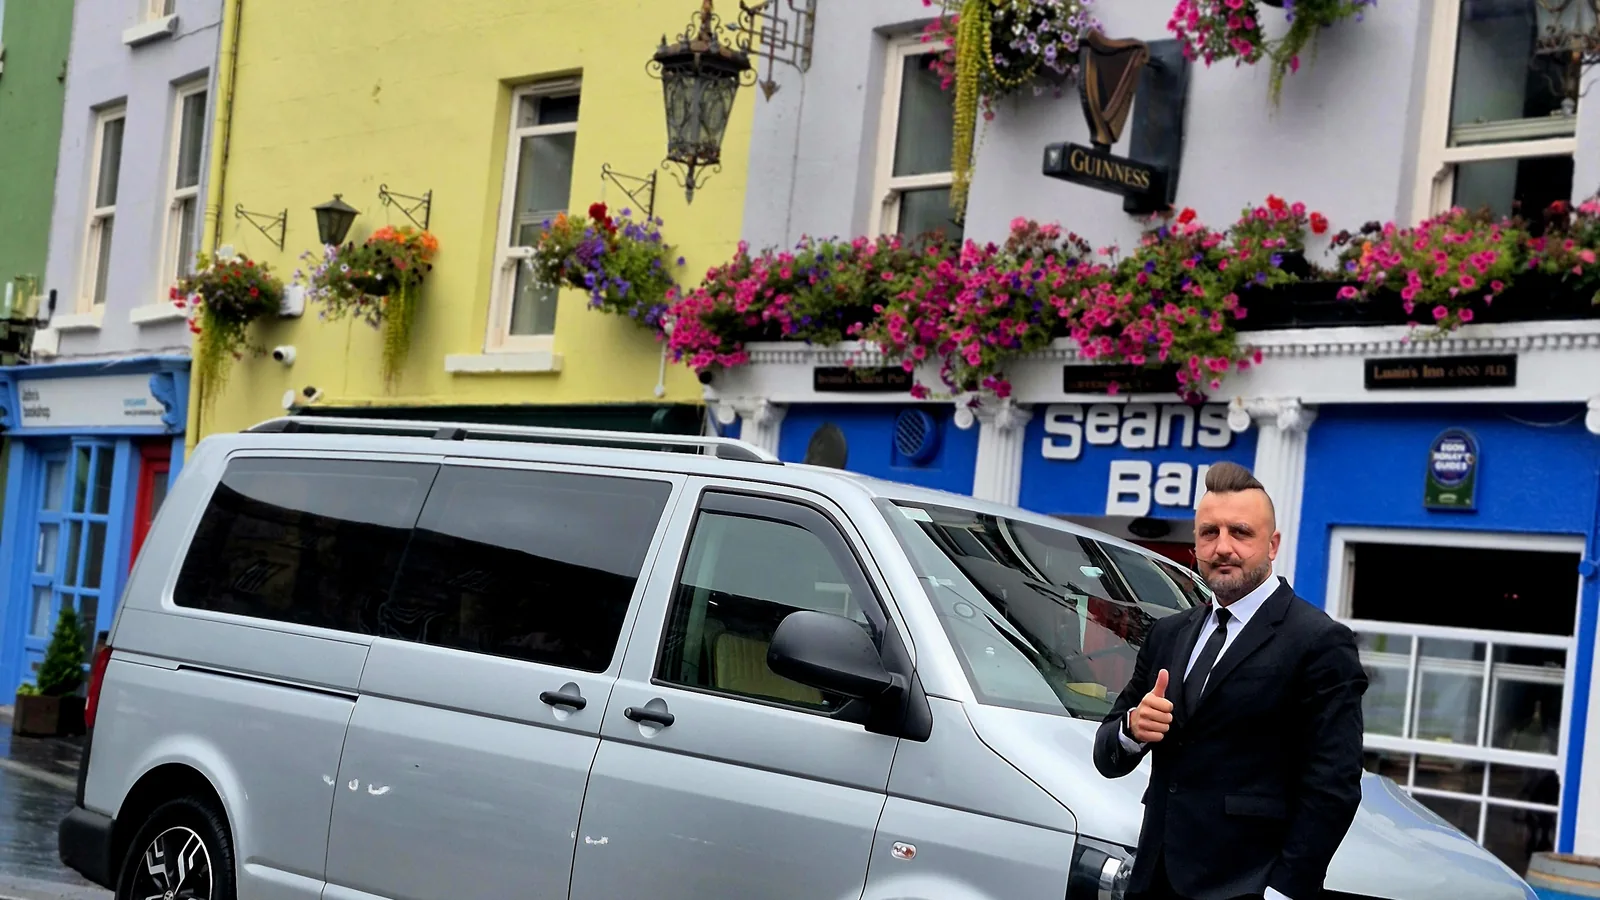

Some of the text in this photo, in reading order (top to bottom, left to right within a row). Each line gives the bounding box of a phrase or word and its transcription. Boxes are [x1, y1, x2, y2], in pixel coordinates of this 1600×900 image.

[1070, 148, 1151, 189] GUINNESS
[1422, 364, 1445, 379] Inn
[1041, 403, 1231, 460] Seans
[1441, 443, 1466, 452] EGON
